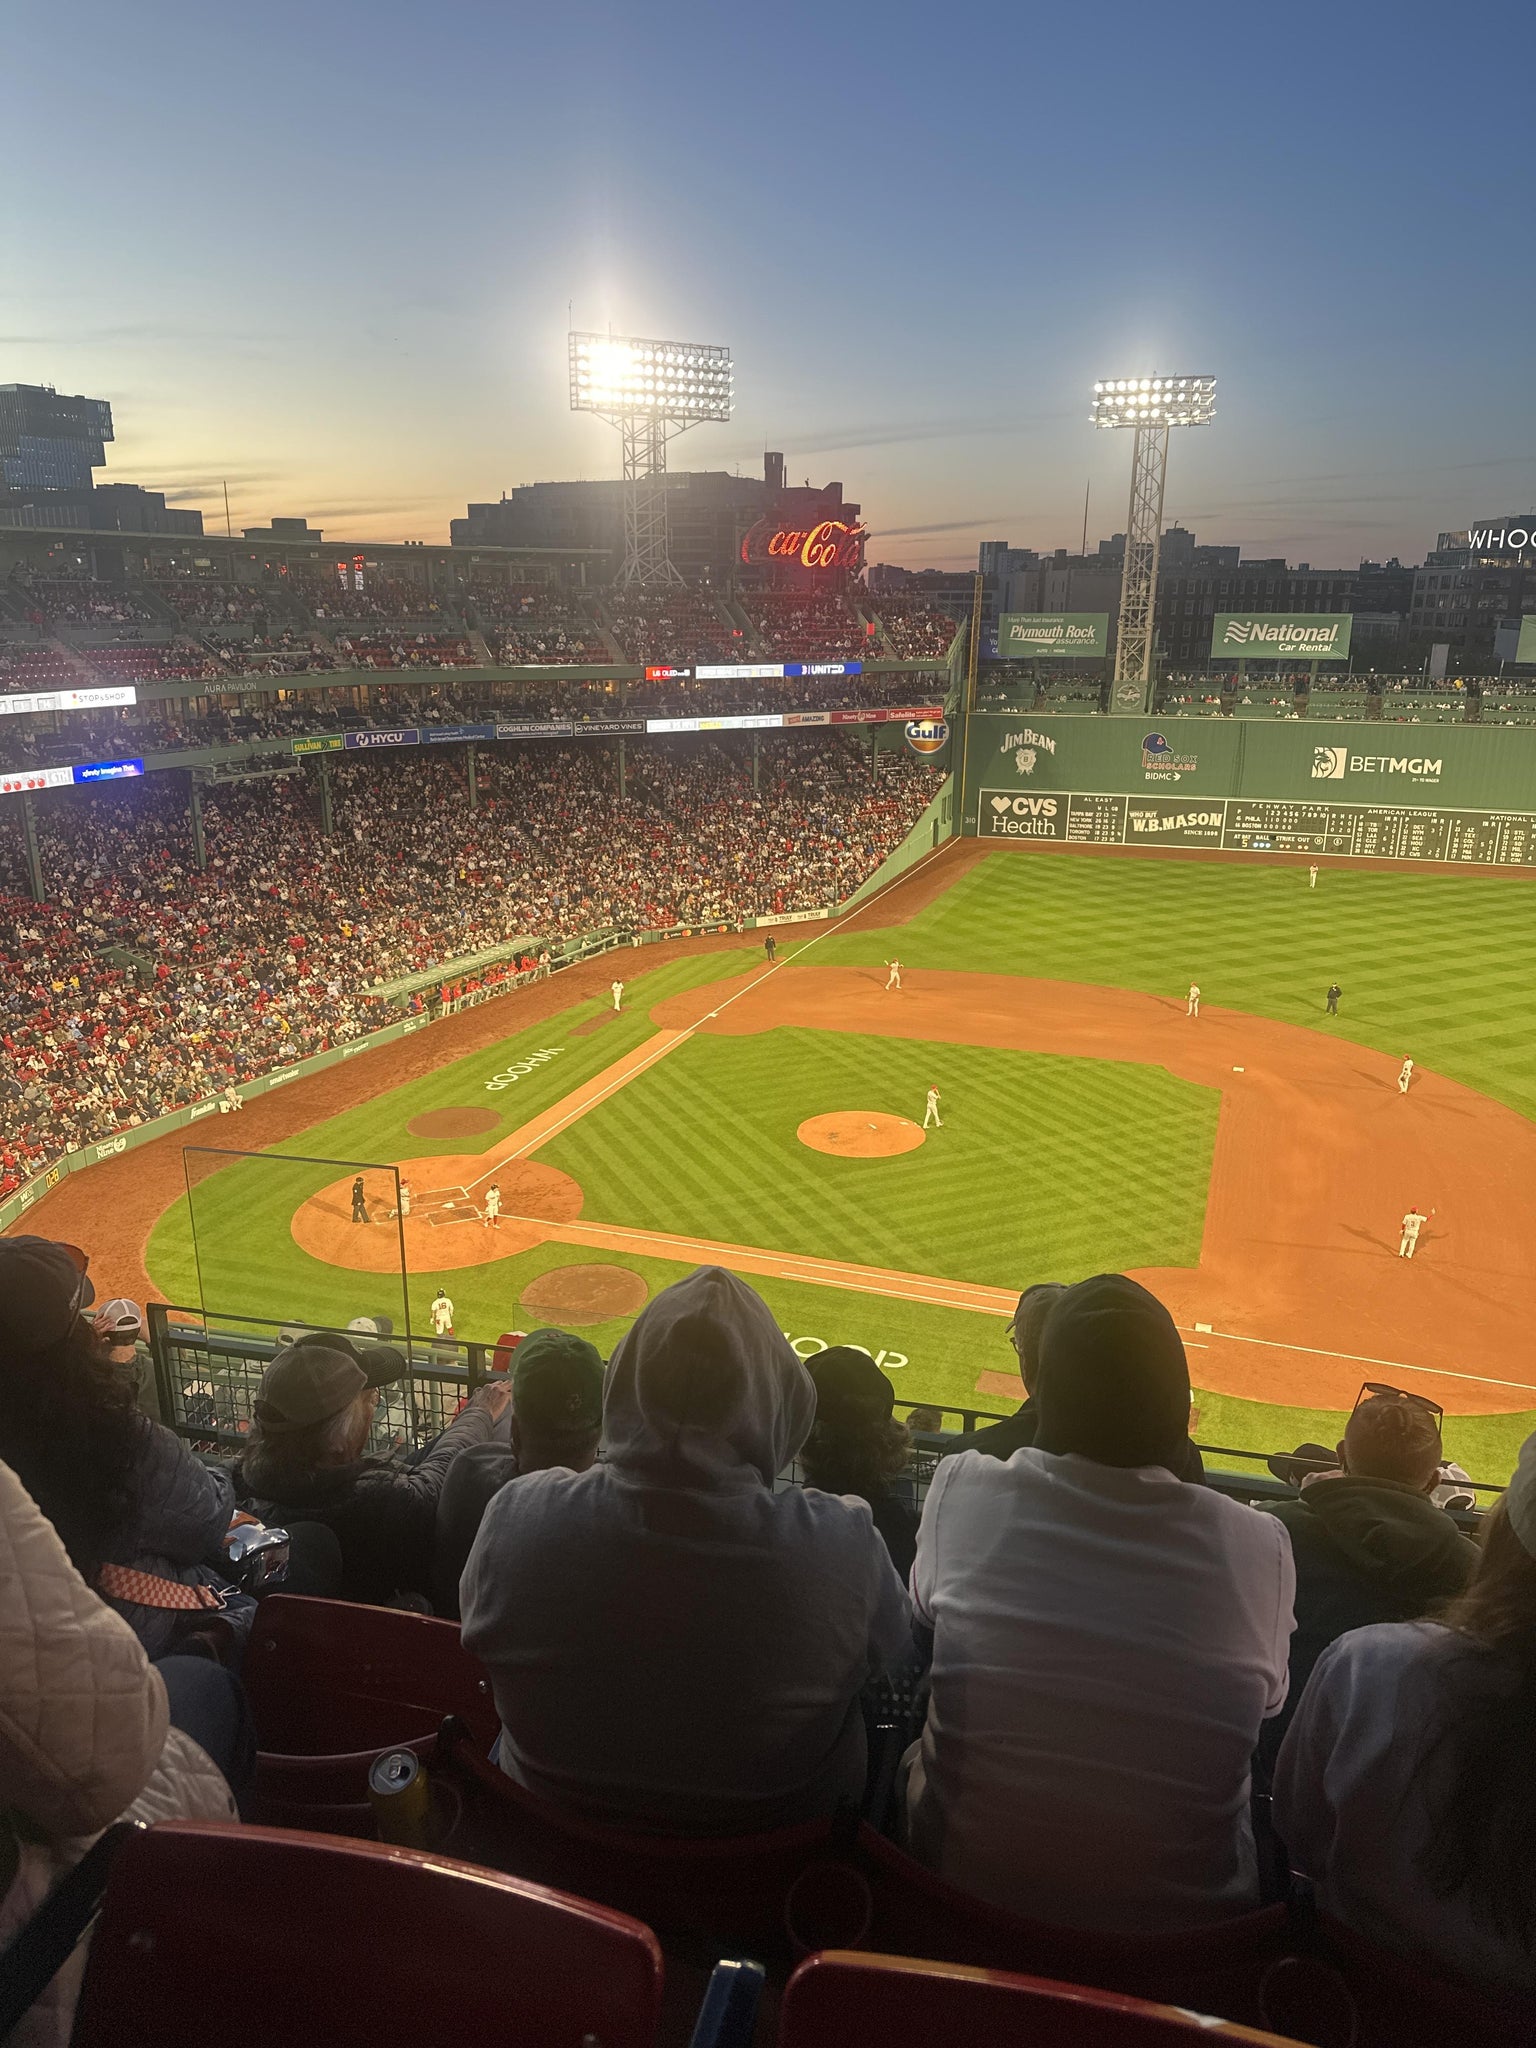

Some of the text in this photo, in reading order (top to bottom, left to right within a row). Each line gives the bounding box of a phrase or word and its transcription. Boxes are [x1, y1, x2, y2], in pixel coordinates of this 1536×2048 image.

[1010, 625, 1064, 639] Plymouth
[1066, 625, 1096, 638] Rock
[1250, 624, 1339, 642] National
[1298, 644, 1332, 652] Rental
[812, 664, 845, 674] UNITED
[228, 682, 257, 691] PAVILION
[498, 724, 572, 733] COGHLIN COMPANIES
[907, 724, 947, 739] Gulf
[372, 734, 403, 744] HYCU
[1000, 728, 1057, 756] JIM BEAM
[294, 740, 341, 752] SULLIVAN TIRE
[1147, 754, 1198, 764] RED SOX
[1146, 762, 1197, 771] SCHOLARS
[1350, 756, 1443, 775] BETMGM
[1145, 772, 1172, 781] BIDMC
[1012, 798, 1058, 817] CVS
[1368, 808, 1438, 818] AMERICAN LEAGUE
[1490, 815, 1528, 823] NATIONAL
[992, 816, 1056, 836] Health
[1242, 838, 1248, 848] 5
[484, 1048, 565, 1091] WHOOP
[270, 1069, 300, 1086] smartwater
[190, 1102, 216, 1119] Franklin
[96, 1148, 115, 1159] Nine
[438, 1302, 447, 1310] 16
